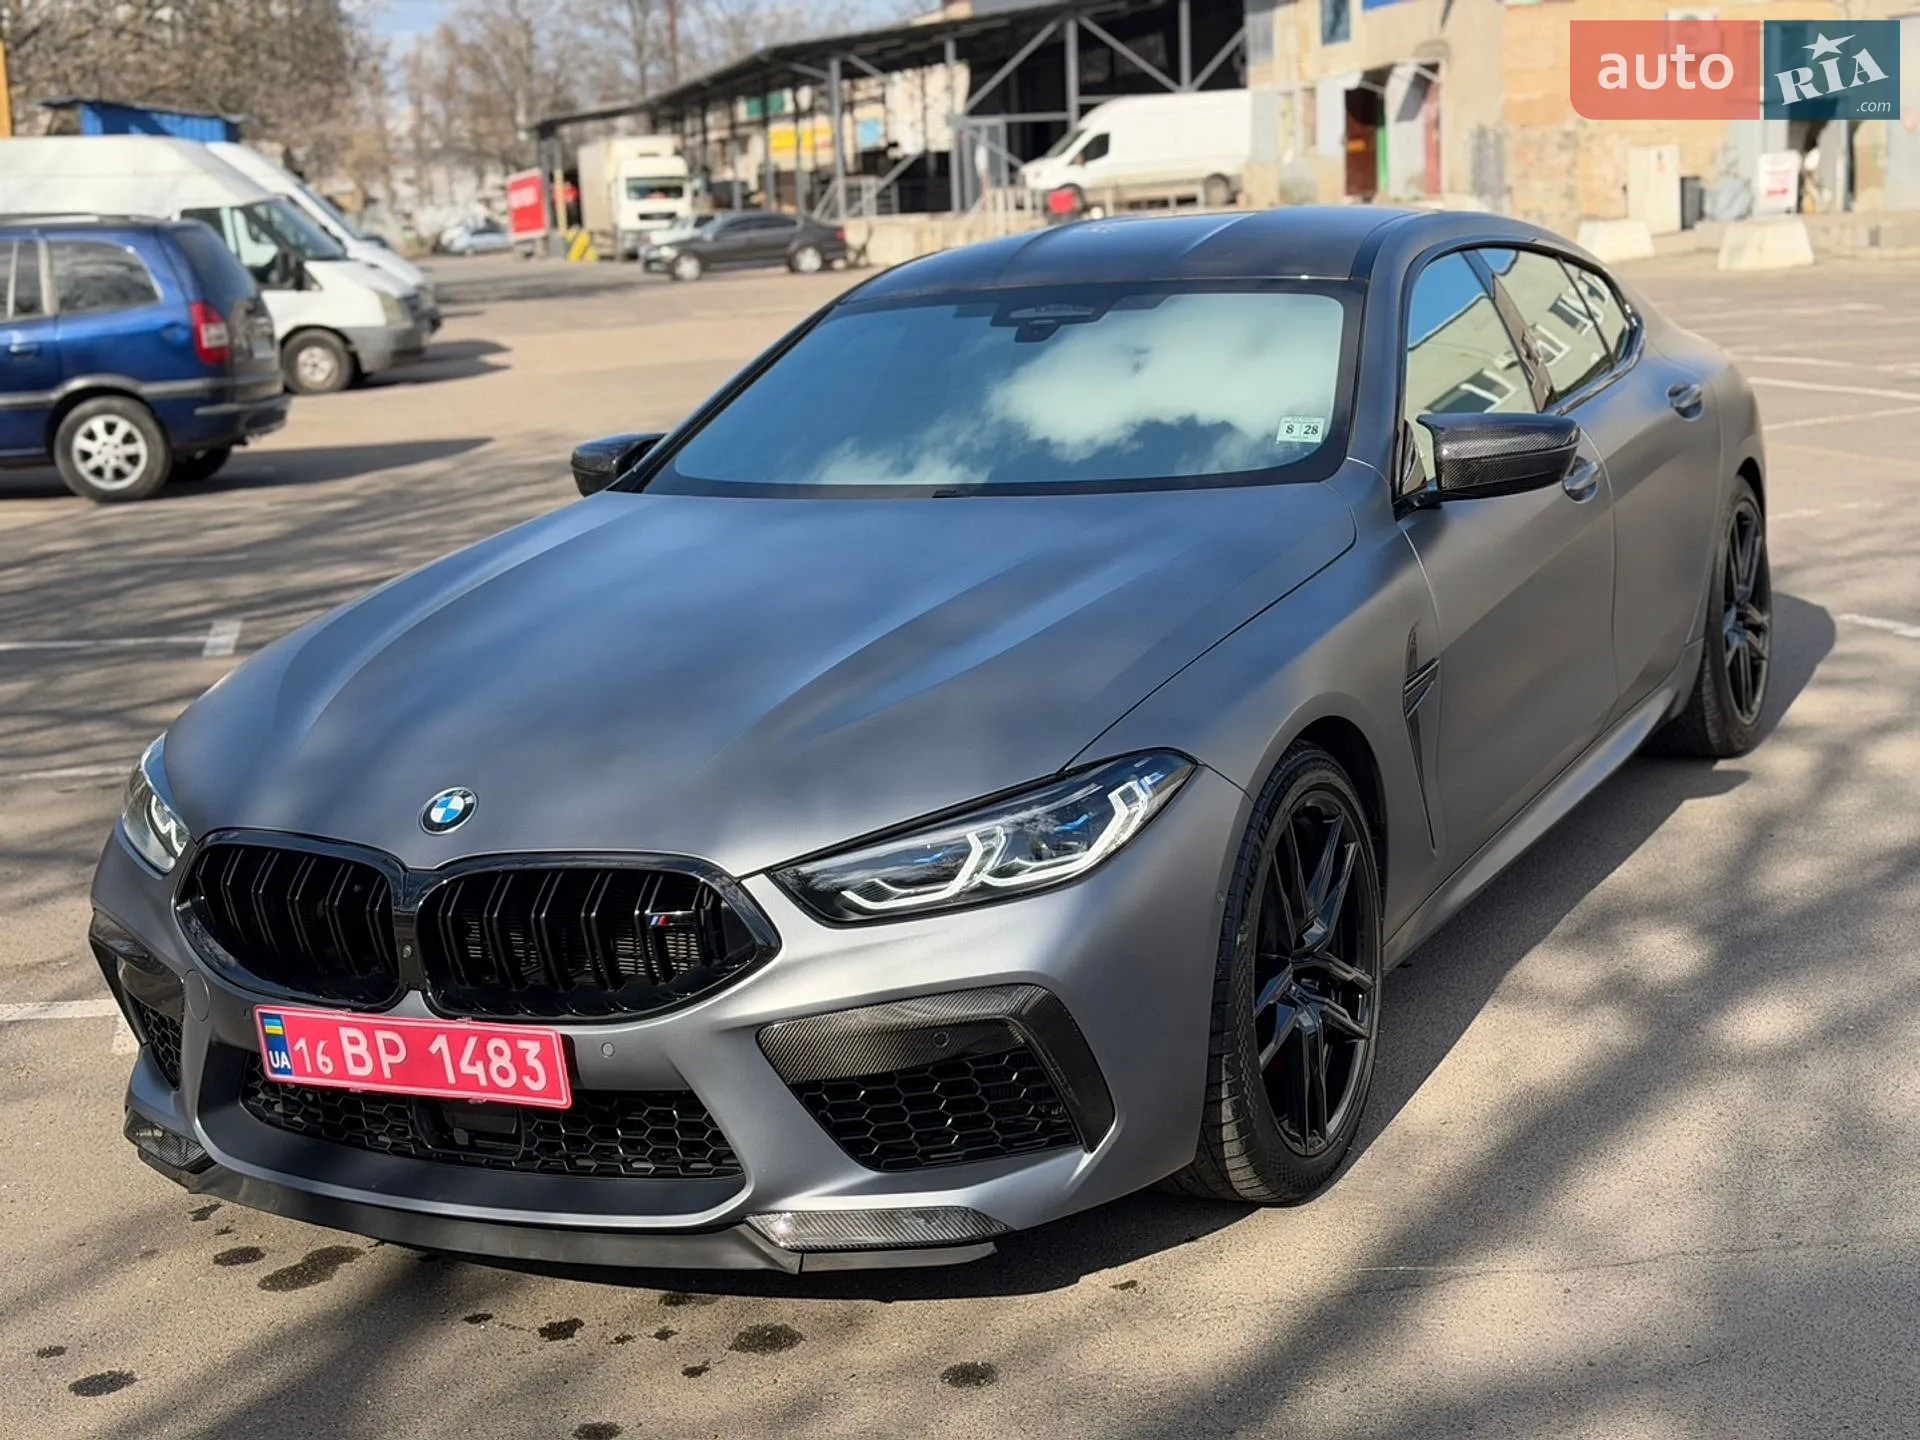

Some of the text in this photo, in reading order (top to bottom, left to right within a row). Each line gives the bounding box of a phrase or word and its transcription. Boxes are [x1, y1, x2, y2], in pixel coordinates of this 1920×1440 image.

[1286, 424, 1319, 435] 8 28
[268, 1050, 292, 1070] UA
[293, 1026, 547, 1092] 16 BP 1483
